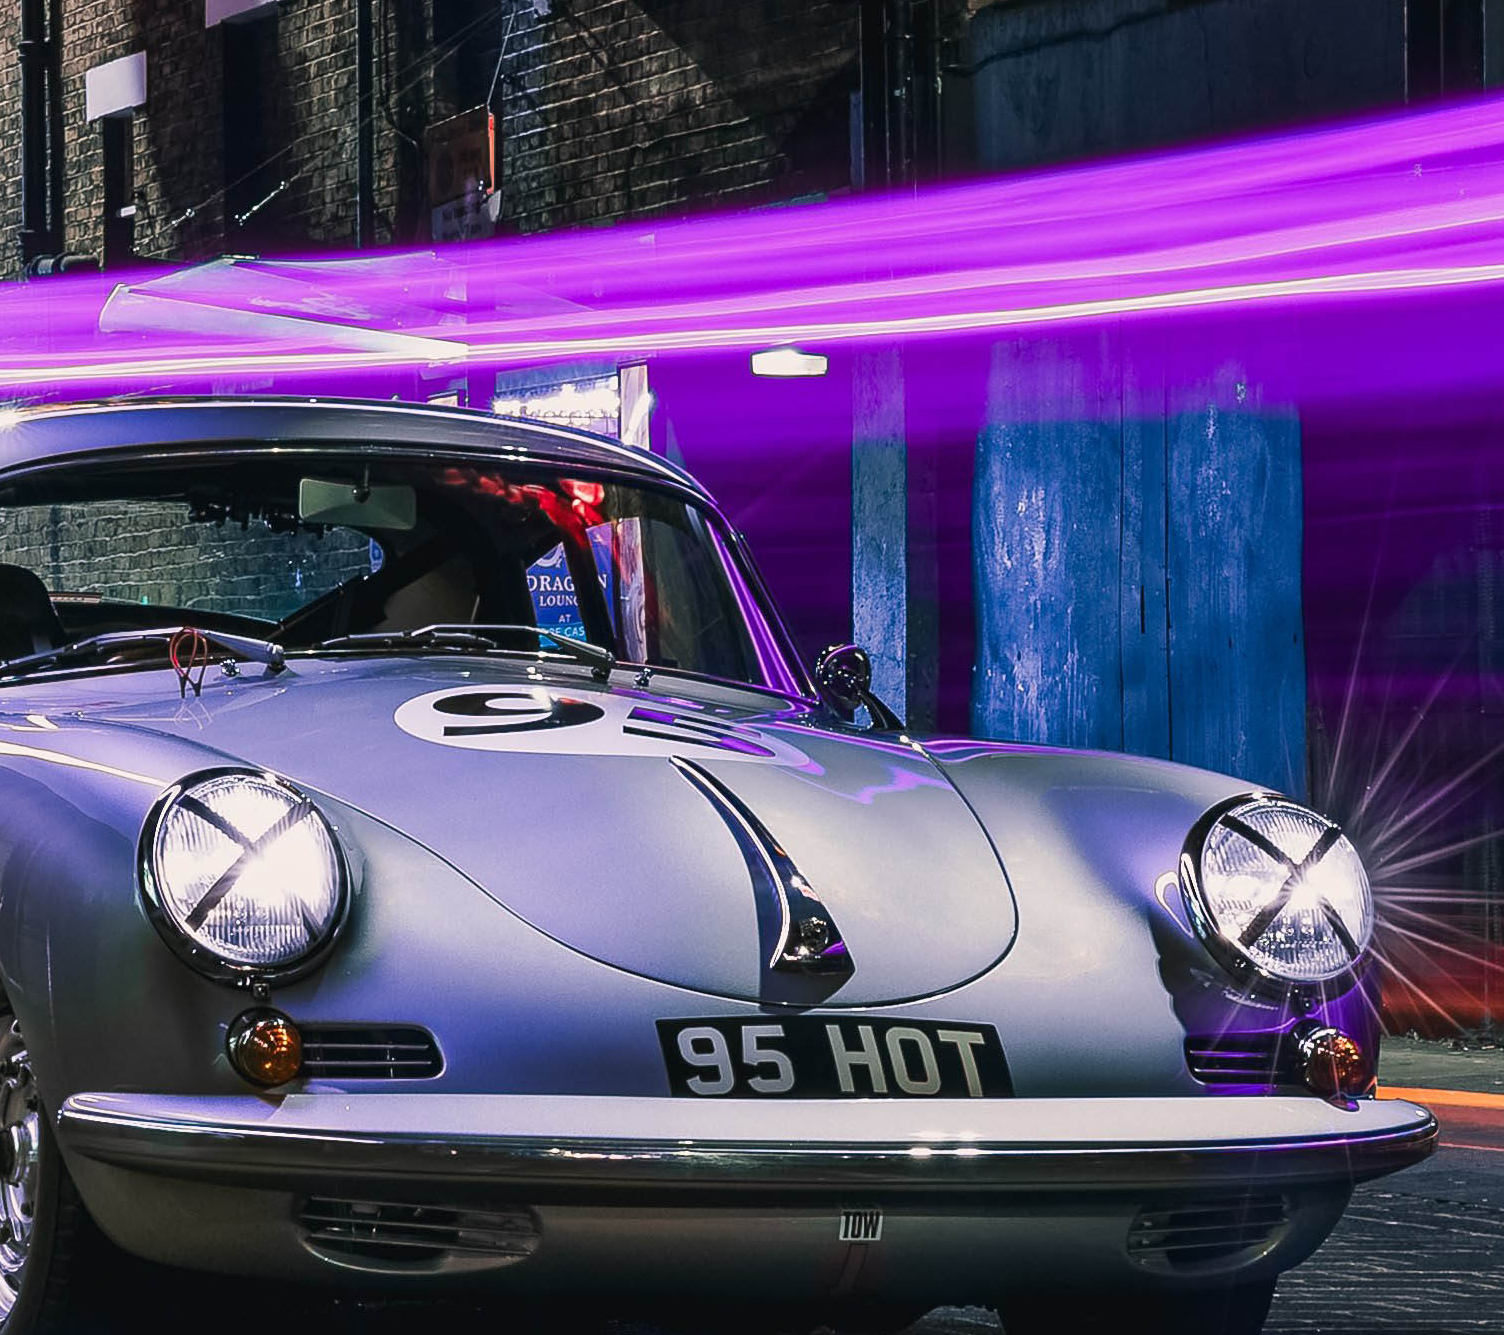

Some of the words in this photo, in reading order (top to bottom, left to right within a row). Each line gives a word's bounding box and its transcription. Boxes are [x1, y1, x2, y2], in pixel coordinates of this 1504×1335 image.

[527, 574, 607, 592] DRAGN
[558, 613, 572, 623] AT
[432, 691, 777, 758] 95
[676, 1023, 796, 1096] 95
[824, 1023, 986, 1099] HOT
[841, 1210, 882, 1239] TOW
